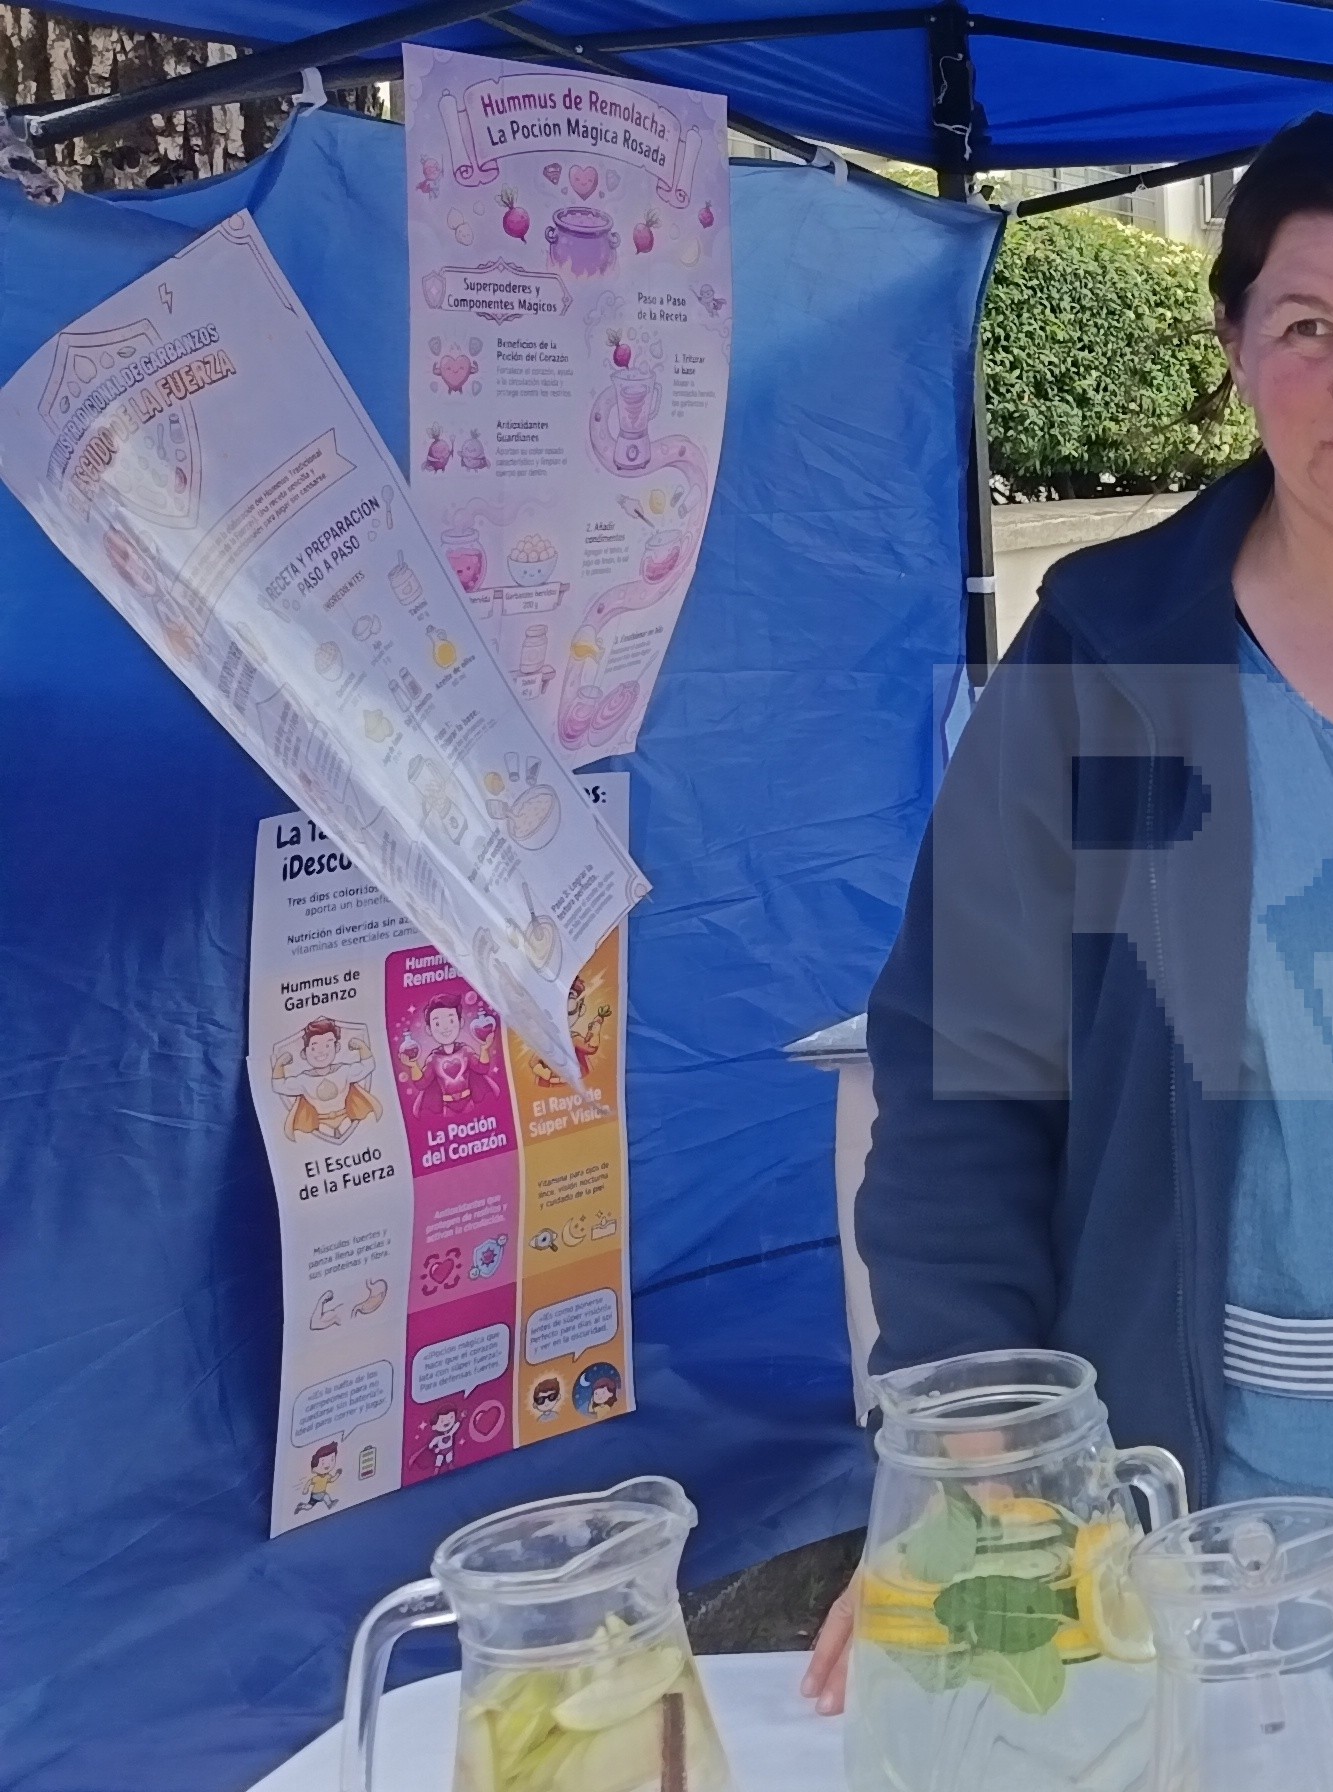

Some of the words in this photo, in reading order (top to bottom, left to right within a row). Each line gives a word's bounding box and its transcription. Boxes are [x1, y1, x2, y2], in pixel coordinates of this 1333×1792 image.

[481, 93, 557, 117] Hummus
[563, 88, 582, 110] de
[589, 90, 670, 142] Remolacha:
[487, 126, 507, 146] La
[511, 117, 561, 140] Poción
[567, 118, 618, 146] Mágica
[623, 130, 666, 167] Rosada
[464, 278, 532, 295] Superpoderes
[535, 286, 540, 297] y
[638, 292, 656, 304] Paso
[660, 297, 663, 305] a
[667, 294, 686, 306] Paso
[448, 294, 514, 311] Componentes
[638, 310, 646, 320] de
[650, 309, 656, 320] la
[660, 309, 687, 322] Receta
[497, 338, 537, 349] Beneficios
[540, 341, 548, 349] de
[551, 340, 557, 349] la
[497, 351, 523, 361] Poción
[526, 352, 536, 362] del
[539, 352, 568, 362] Corazón
[61, 374, 127, 445] TRADICIONAL
[120, 363, 144, 388] DE
[139, 324, 219, 376] GARBANZOS
[129, 388, 164, 424] LA
[155, 349, 236, 407] FUERZA
[497, 421, 548, 430] Antioxidantes
[497, 432, 539, 442] Guardianes
[266, 562, 301, 600] RECETA
[296, 553, 306, 568] Y
[304, 496, 380, 561] PREPARACIÓN
[297, 566, 324, 597] PASO
[323, 559, 333, 573] A
[331, 535, 360, 565] PASO
[277, 825, 300, 849] La
[283, 852, 352, 881] ¡Descu
[287, 897, 306, 907] Tres
[310, 892, 330, 904] dips
[333, 884, 379, 899] coloridos
[305, 903, 337, 917] aporta
[340, 901, 353, 910] un
[287, 931, 332, 945] Nutrición
[382, 918, 395, 926] sin
[291, 939, 338, 956] vitaminas
[341, 931, 389, 946] esenciales
[280, 974, 339, 995] Hummus
[344, 969, 361, 982] de
[284, 988, 356, 1011] Garbanzo
[533, 1101, 546, 1117] El
[549, 1094, 581, 1113] Rayo
[427, 1130, 446, 1146] La
[448, 1115, 497, 1140] Poción
[529, 1116, 568, 1138] Súper
[305, 1161, 320, 1178] El
[325, 1147, 382, 1173] Escudo
[422, 1149, 446, 1168] del
[449, 1133, 507, 1159] Corazón
[299, 1184, 319, 1201] de
[323, 1179, 337, 1194] la
[343, 1164, 394, 1189] Fuerza
